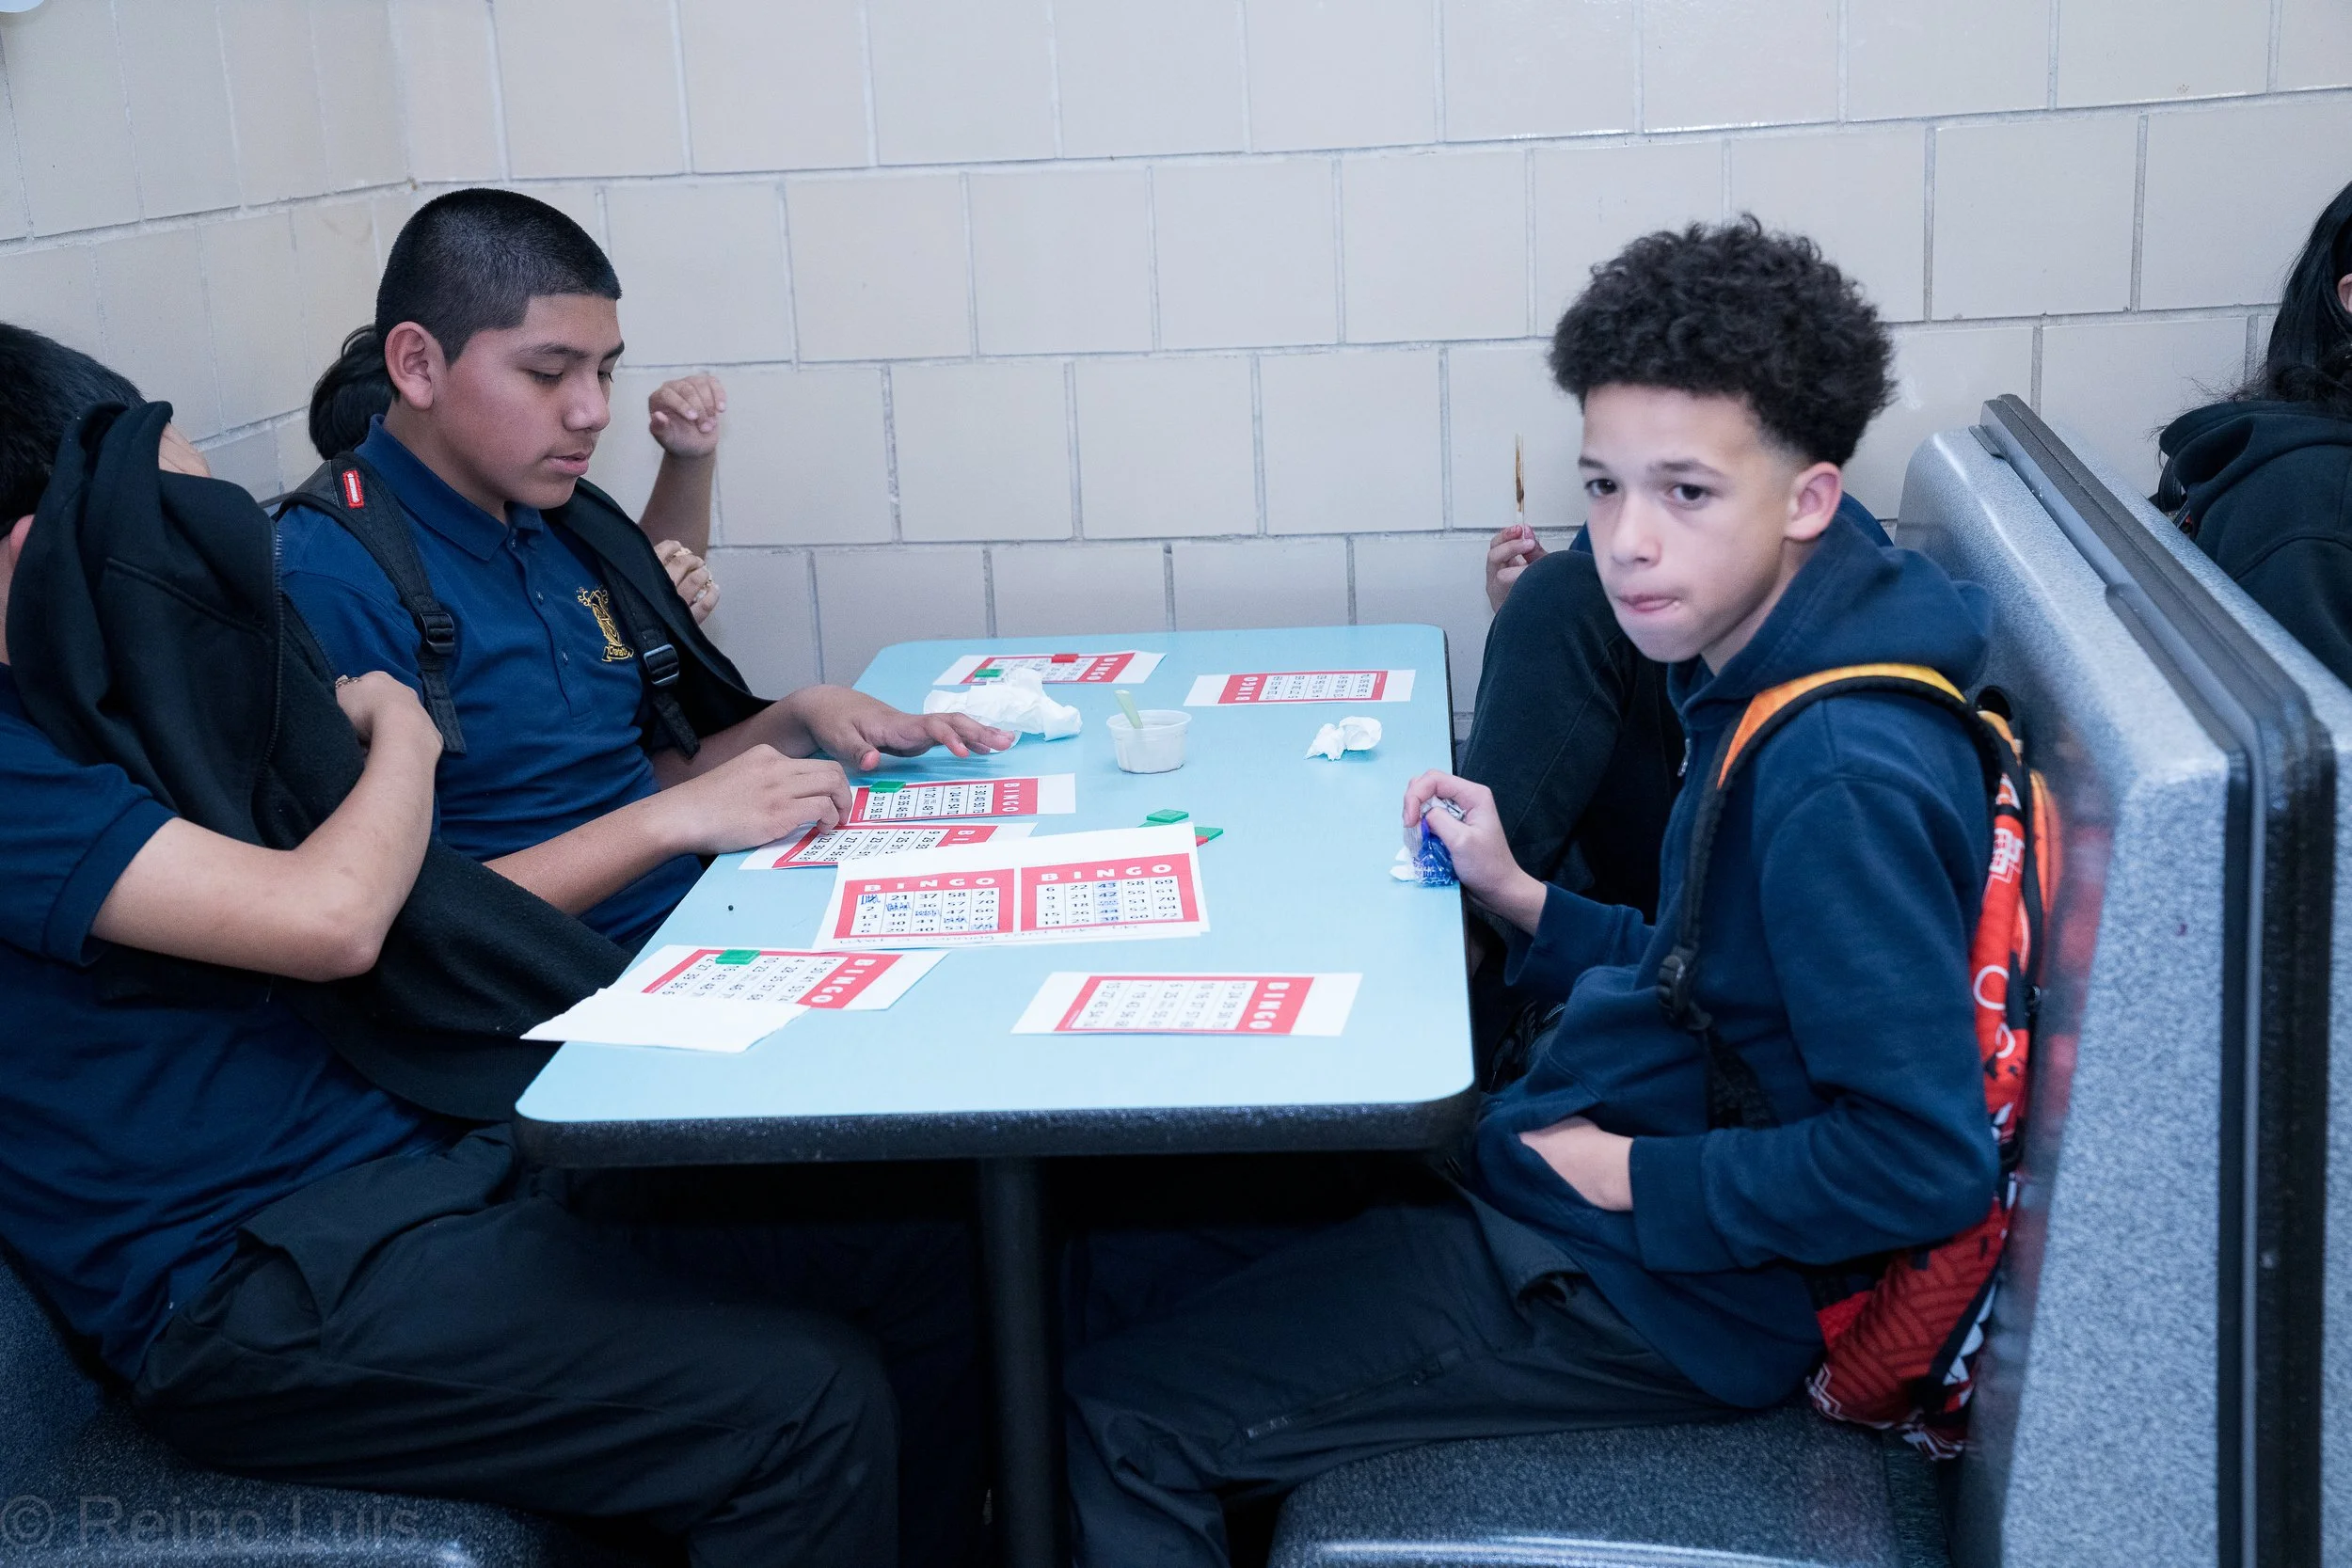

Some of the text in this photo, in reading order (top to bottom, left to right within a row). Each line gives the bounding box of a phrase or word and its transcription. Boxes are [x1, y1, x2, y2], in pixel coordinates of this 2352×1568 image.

[1002, 782, 1020, 812] BINGO
[864, 877, 995, 892] BINGO
[1041, 863, 1172, 881] BINGO
[811, 958, 877, 1004] BINGO
[1248, 981, 1290, 1029] BINGO
